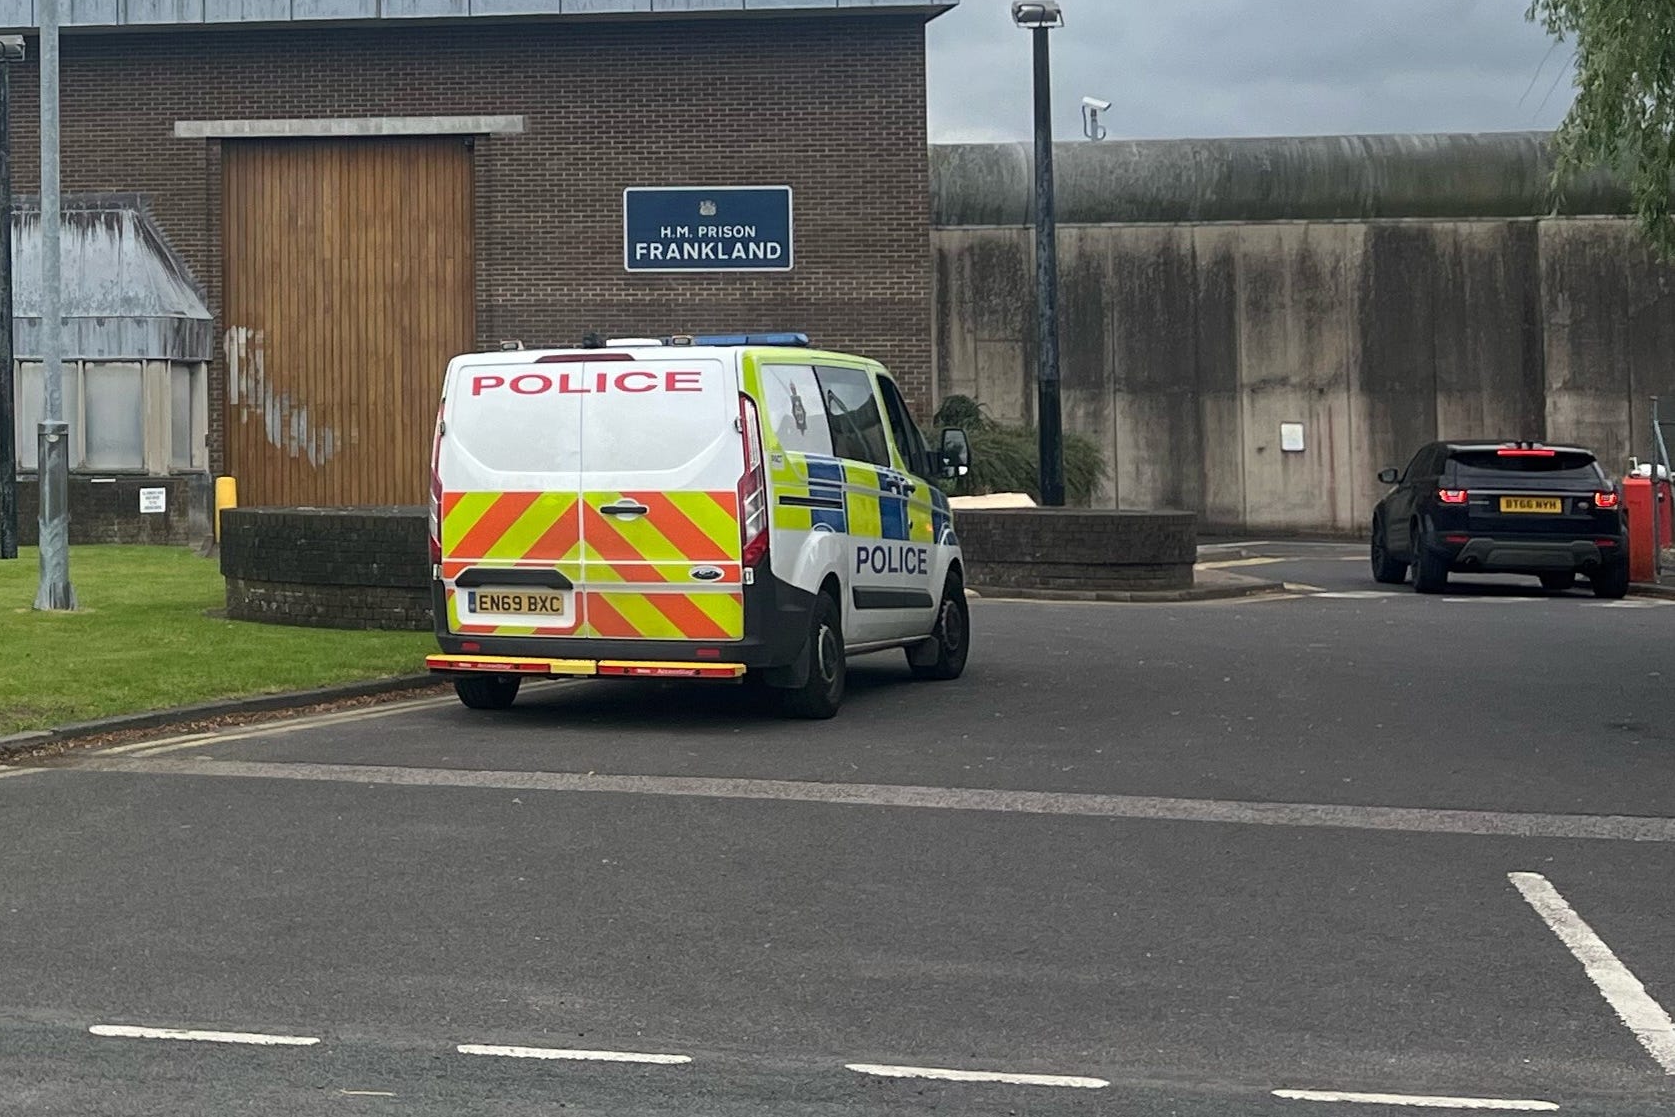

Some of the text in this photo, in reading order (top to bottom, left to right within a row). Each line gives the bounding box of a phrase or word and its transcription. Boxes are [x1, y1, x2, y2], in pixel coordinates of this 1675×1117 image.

[660, 225, 756, 238] H.M. PRISON
[635, 242, 782, 260] FRANKLAND
[472, 371, 703, 396] POLICE
[856, 545, 928, 575] POLICE
[479, 594, 561, 612] EN69 BXC
